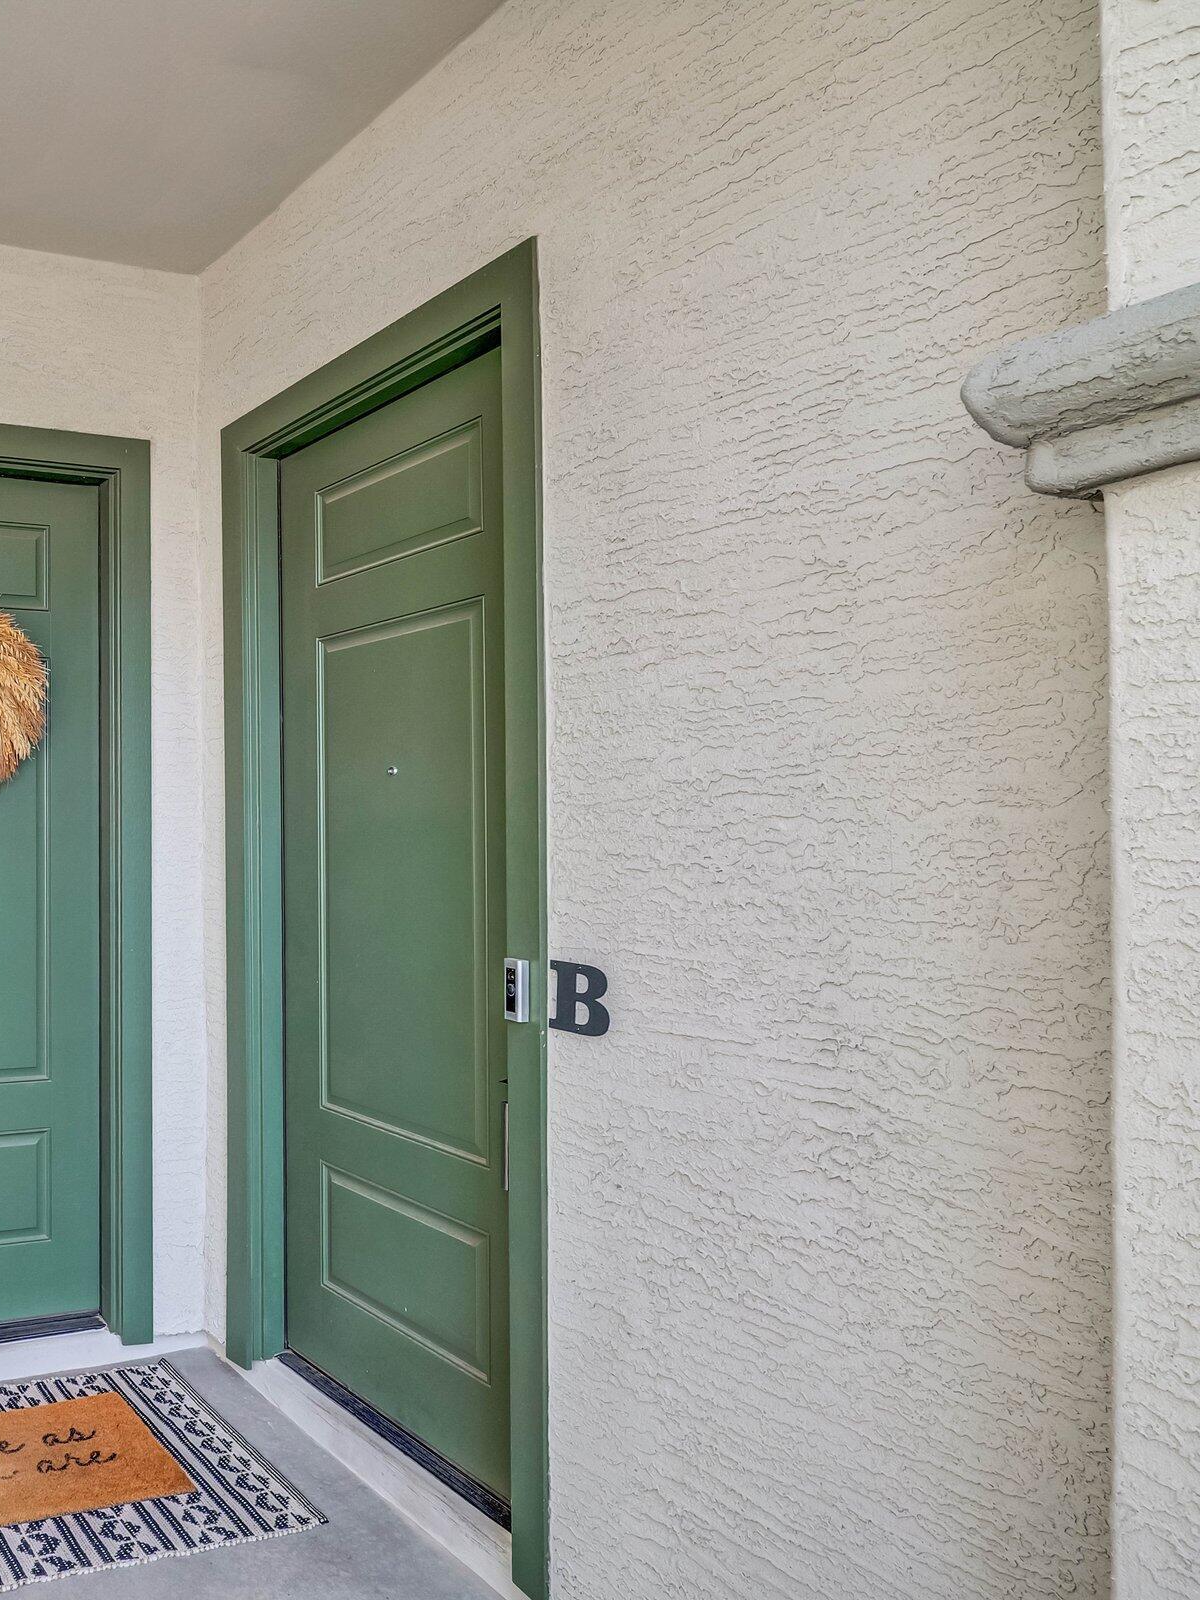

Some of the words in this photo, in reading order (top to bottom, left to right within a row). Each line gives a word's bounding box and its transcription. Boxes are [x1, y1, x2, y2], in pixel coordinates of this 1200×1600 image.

[548, 960, 610, 1037] B
[42, 1427, 96, 1447] as
[36, 1450, 117, 1473] are
